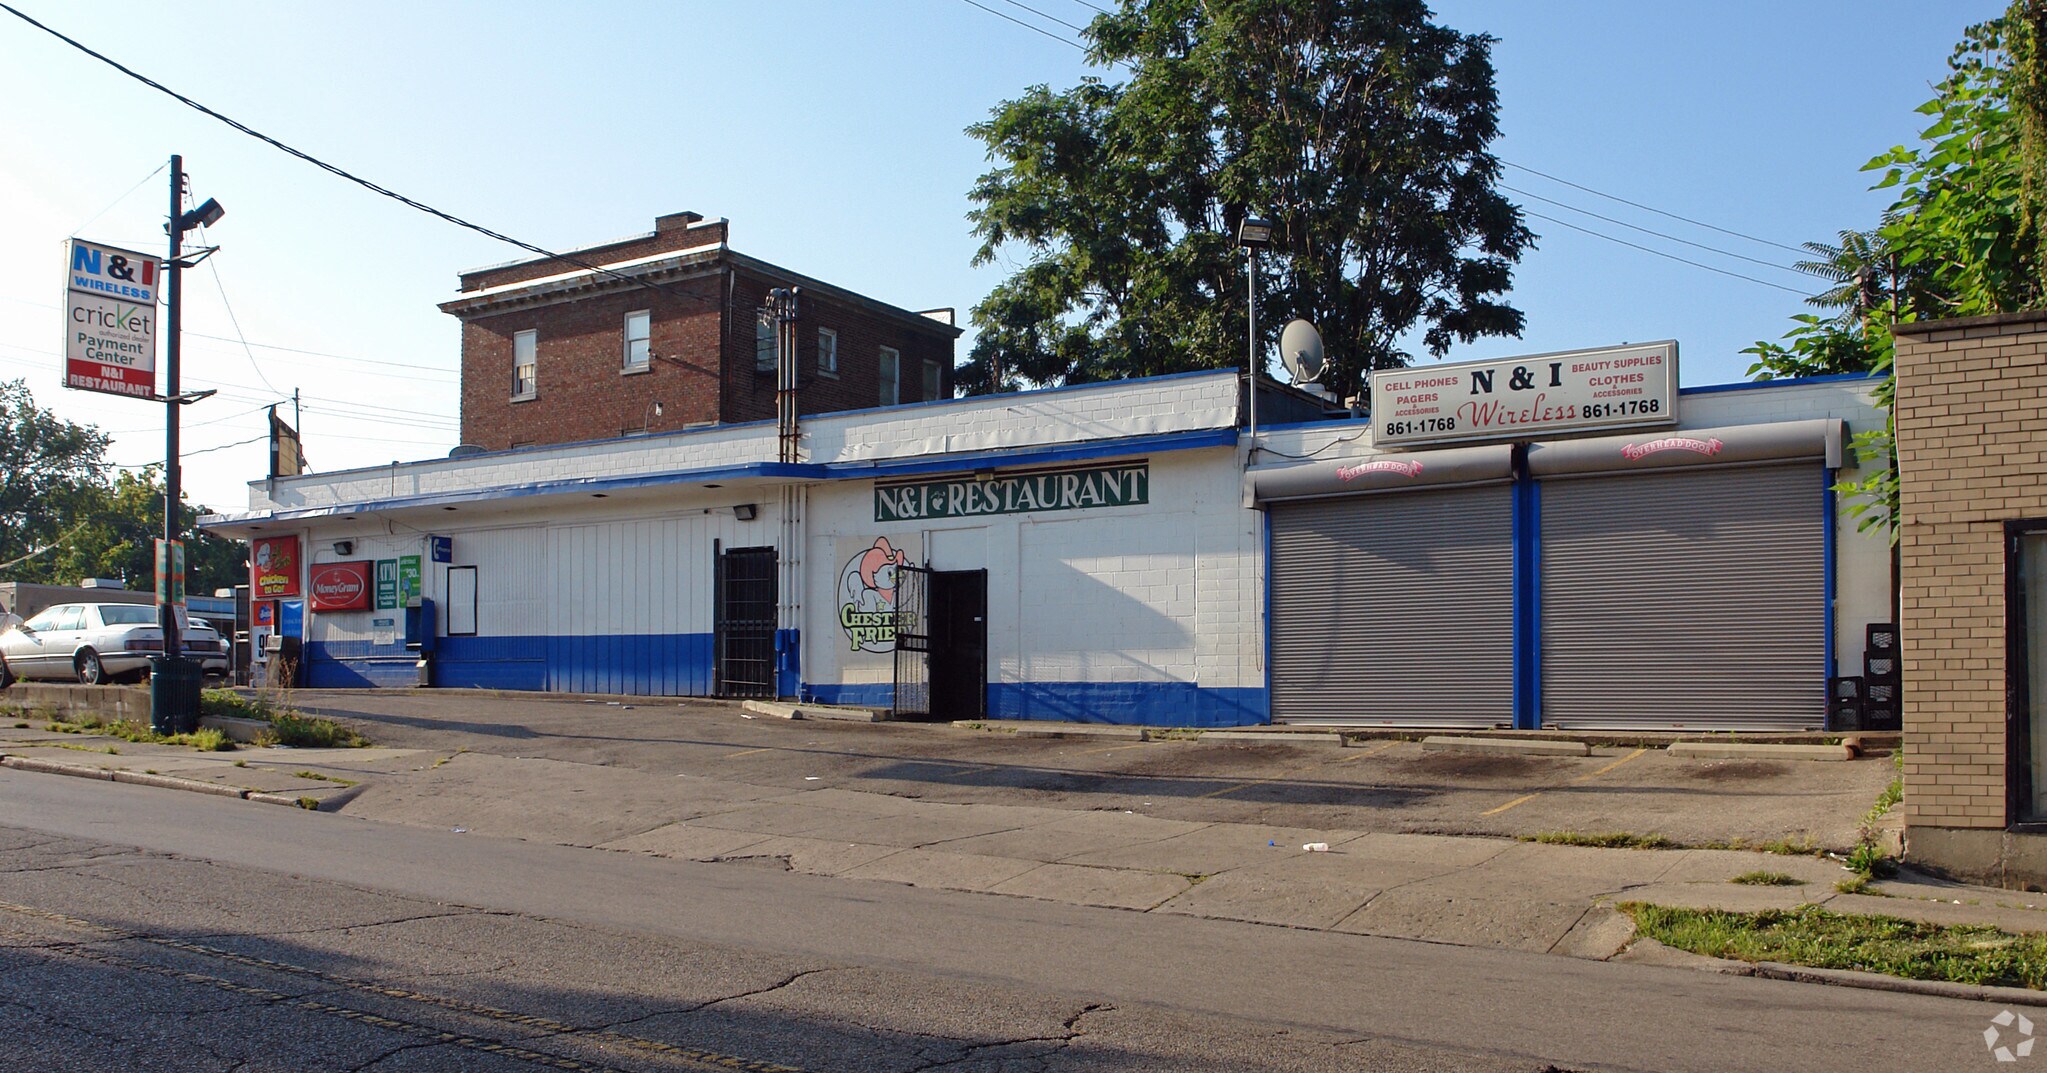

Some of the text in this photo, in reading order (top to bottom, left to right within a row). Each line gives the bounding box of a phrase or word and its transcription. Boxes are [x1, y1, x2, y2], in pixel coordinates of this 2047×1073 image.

[73, 245, 154, 286] N & I
[74, 276, 150, 300] WIRELESS
[78, 332, 143, 354] Payment
[85, 347, 135, 366] Center
[1571, 356, 1661, 373] BEAUTY SUPPLIES
[101, 365, 124, 380] N&I
[1470, 362, 1562, 395] N & I
[1589, 373, 1644, 387] CLOTHES
[70, 374, 151, 396] RESTAURANT
[1385, 377, 1458, 391] CELL PHONES
[1592, 387, 1643, 399] ACCESSORIES
[1396, 392, 1439, 405] PAGERS
[1394, 406, 1439, 417] ACCESSORIES
[1582, 398, 1660, 419] 861-1768
[1386, 417, 1455, 435] 861-1768
[1632, 440, 1710, 458] OVERHEAD DOOR
[1345, 463, 1413, 478] OVERHEAD DOOR
[877, 468, 1146, 520] N&I RESTAURANT
[379, 562, 396, 582] ATM
[316, 582, 359, 596] MoneyGram
